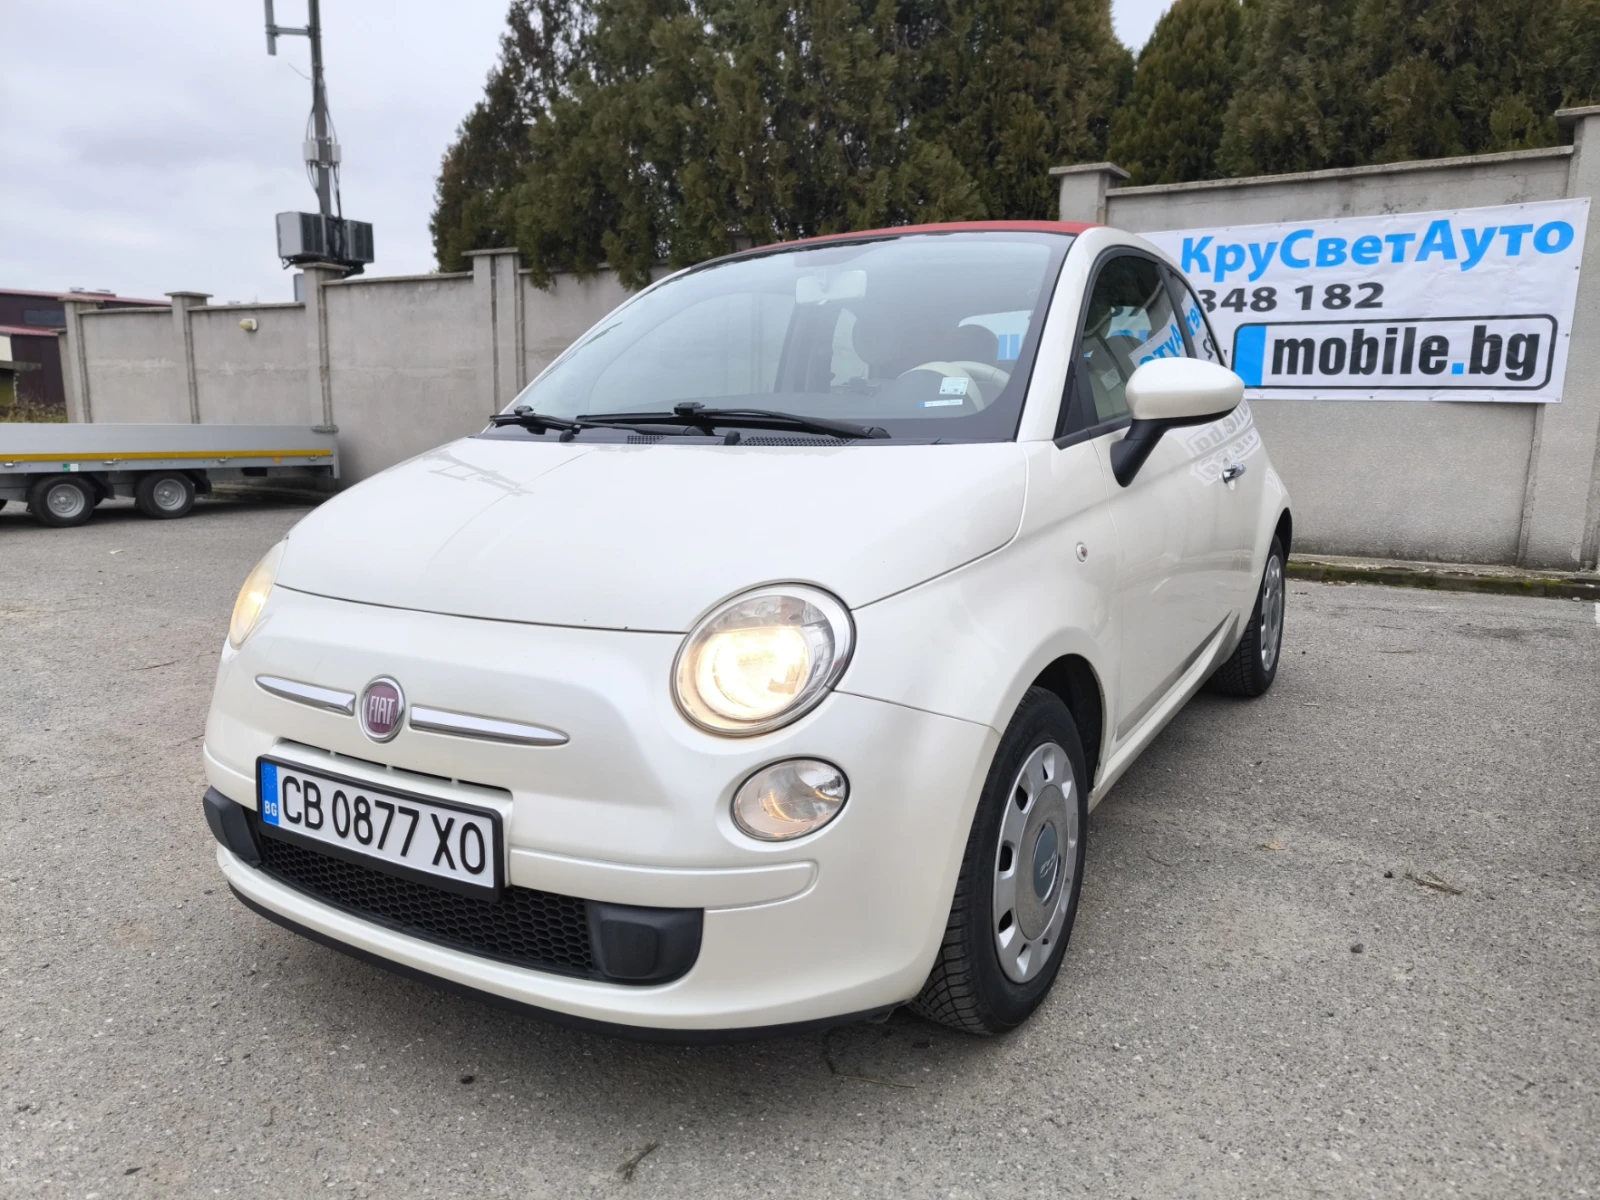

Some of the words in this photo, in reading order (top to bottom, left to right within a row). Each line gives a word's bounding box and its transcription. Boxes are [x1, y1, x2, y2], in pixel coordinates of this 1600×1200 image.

[1181, 219, 1574, 284] КруСветАуто
[1197, 286, 1277, 313] 348
[1295, 282, 1384, 311] 182
[1271, 325, 1541, 381] mobile.bg
[369, 695, 395, 725] FIAT
[265, 800, 277, 816] BG
[282, 775, 324, 830] CB
[331, 789, 420, 857] 0877
[430, 812, 486, 875] XO
